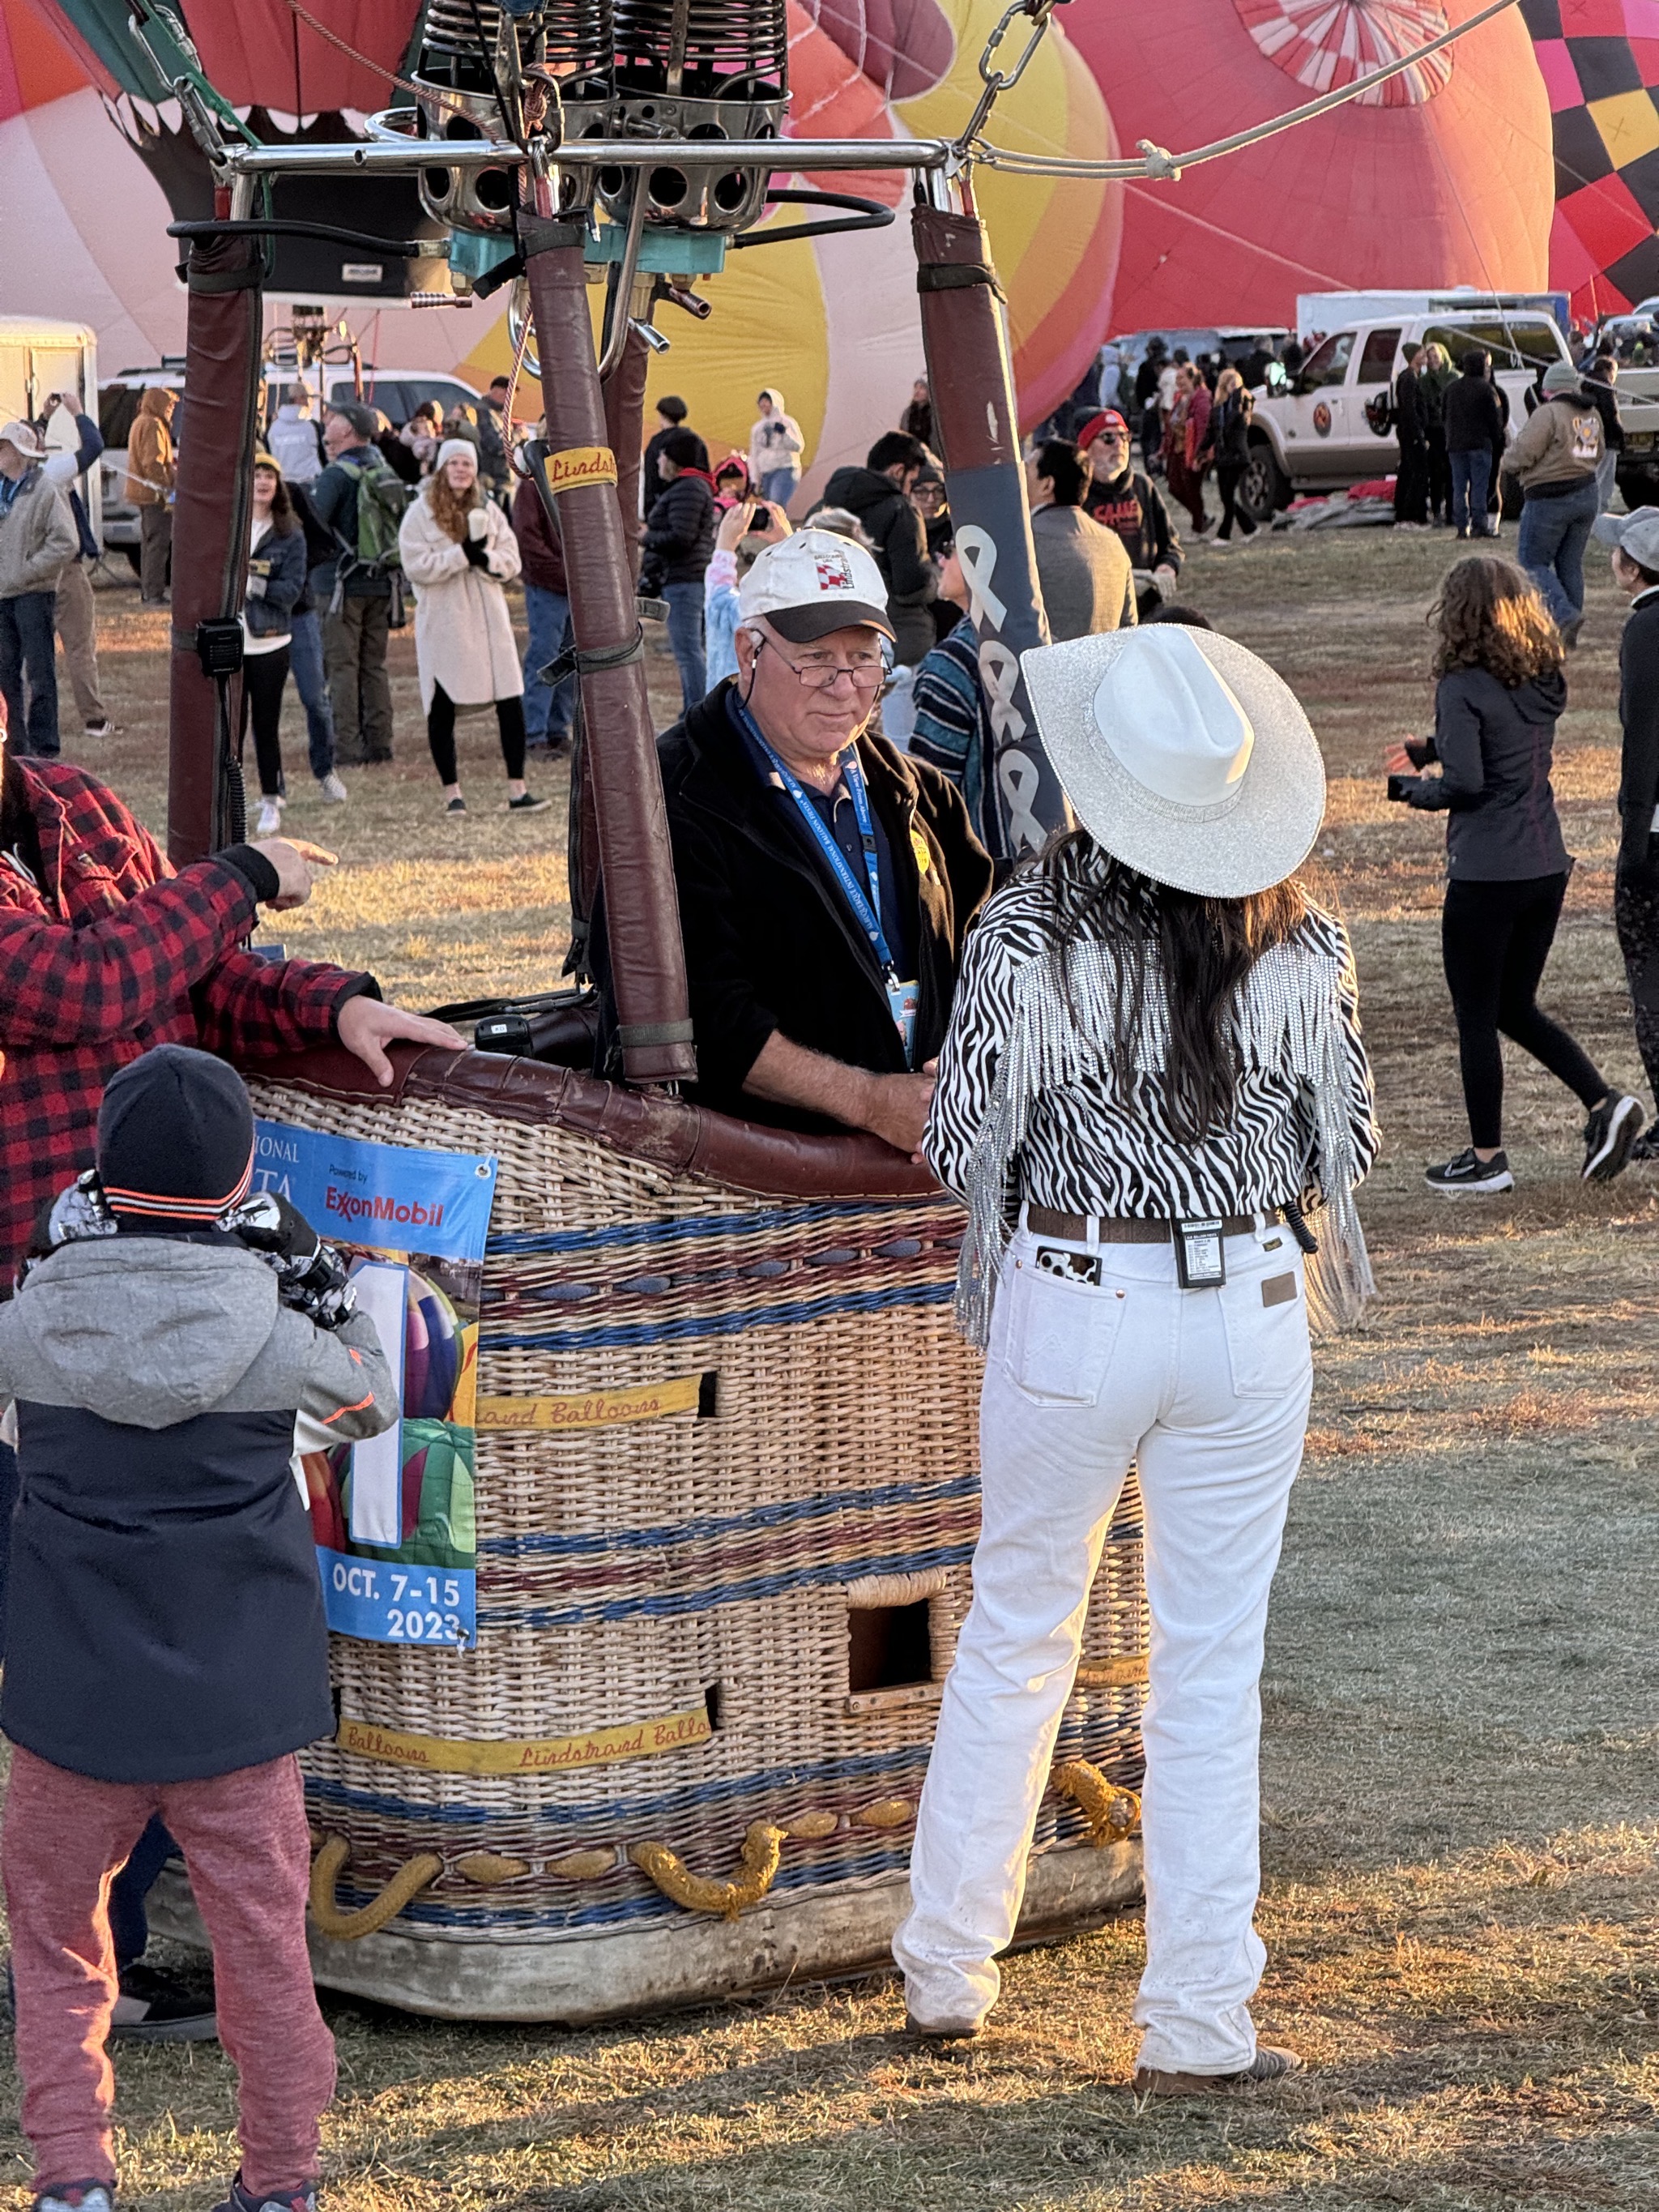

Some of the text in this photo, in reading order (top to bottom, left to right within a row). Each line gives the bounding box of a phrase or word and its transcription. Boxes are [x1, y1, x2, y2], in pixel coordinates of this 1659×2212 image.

[855, 788, 864, 805] From
[859, 804, 868, 823] Above
[812, 818, 830, 845] BALLOON
[826, 845, 853, 890] INTERNATIONAL
[850, 889, 874, 929] ALBUQUERQUE
[329, 1164, 368, 1184] Powered by
[326, 1186, 444, 1227] ExxonMobil
[476, 1399, 661, 1424] and Balloons
[333, 1562, 460, 1607] OCT. 7-15
[387, 1608, 461, 1641] 2023
[348, 1727, 430, 1762] Balloons
[519, 1730, 645, 1767] Lindstrand
